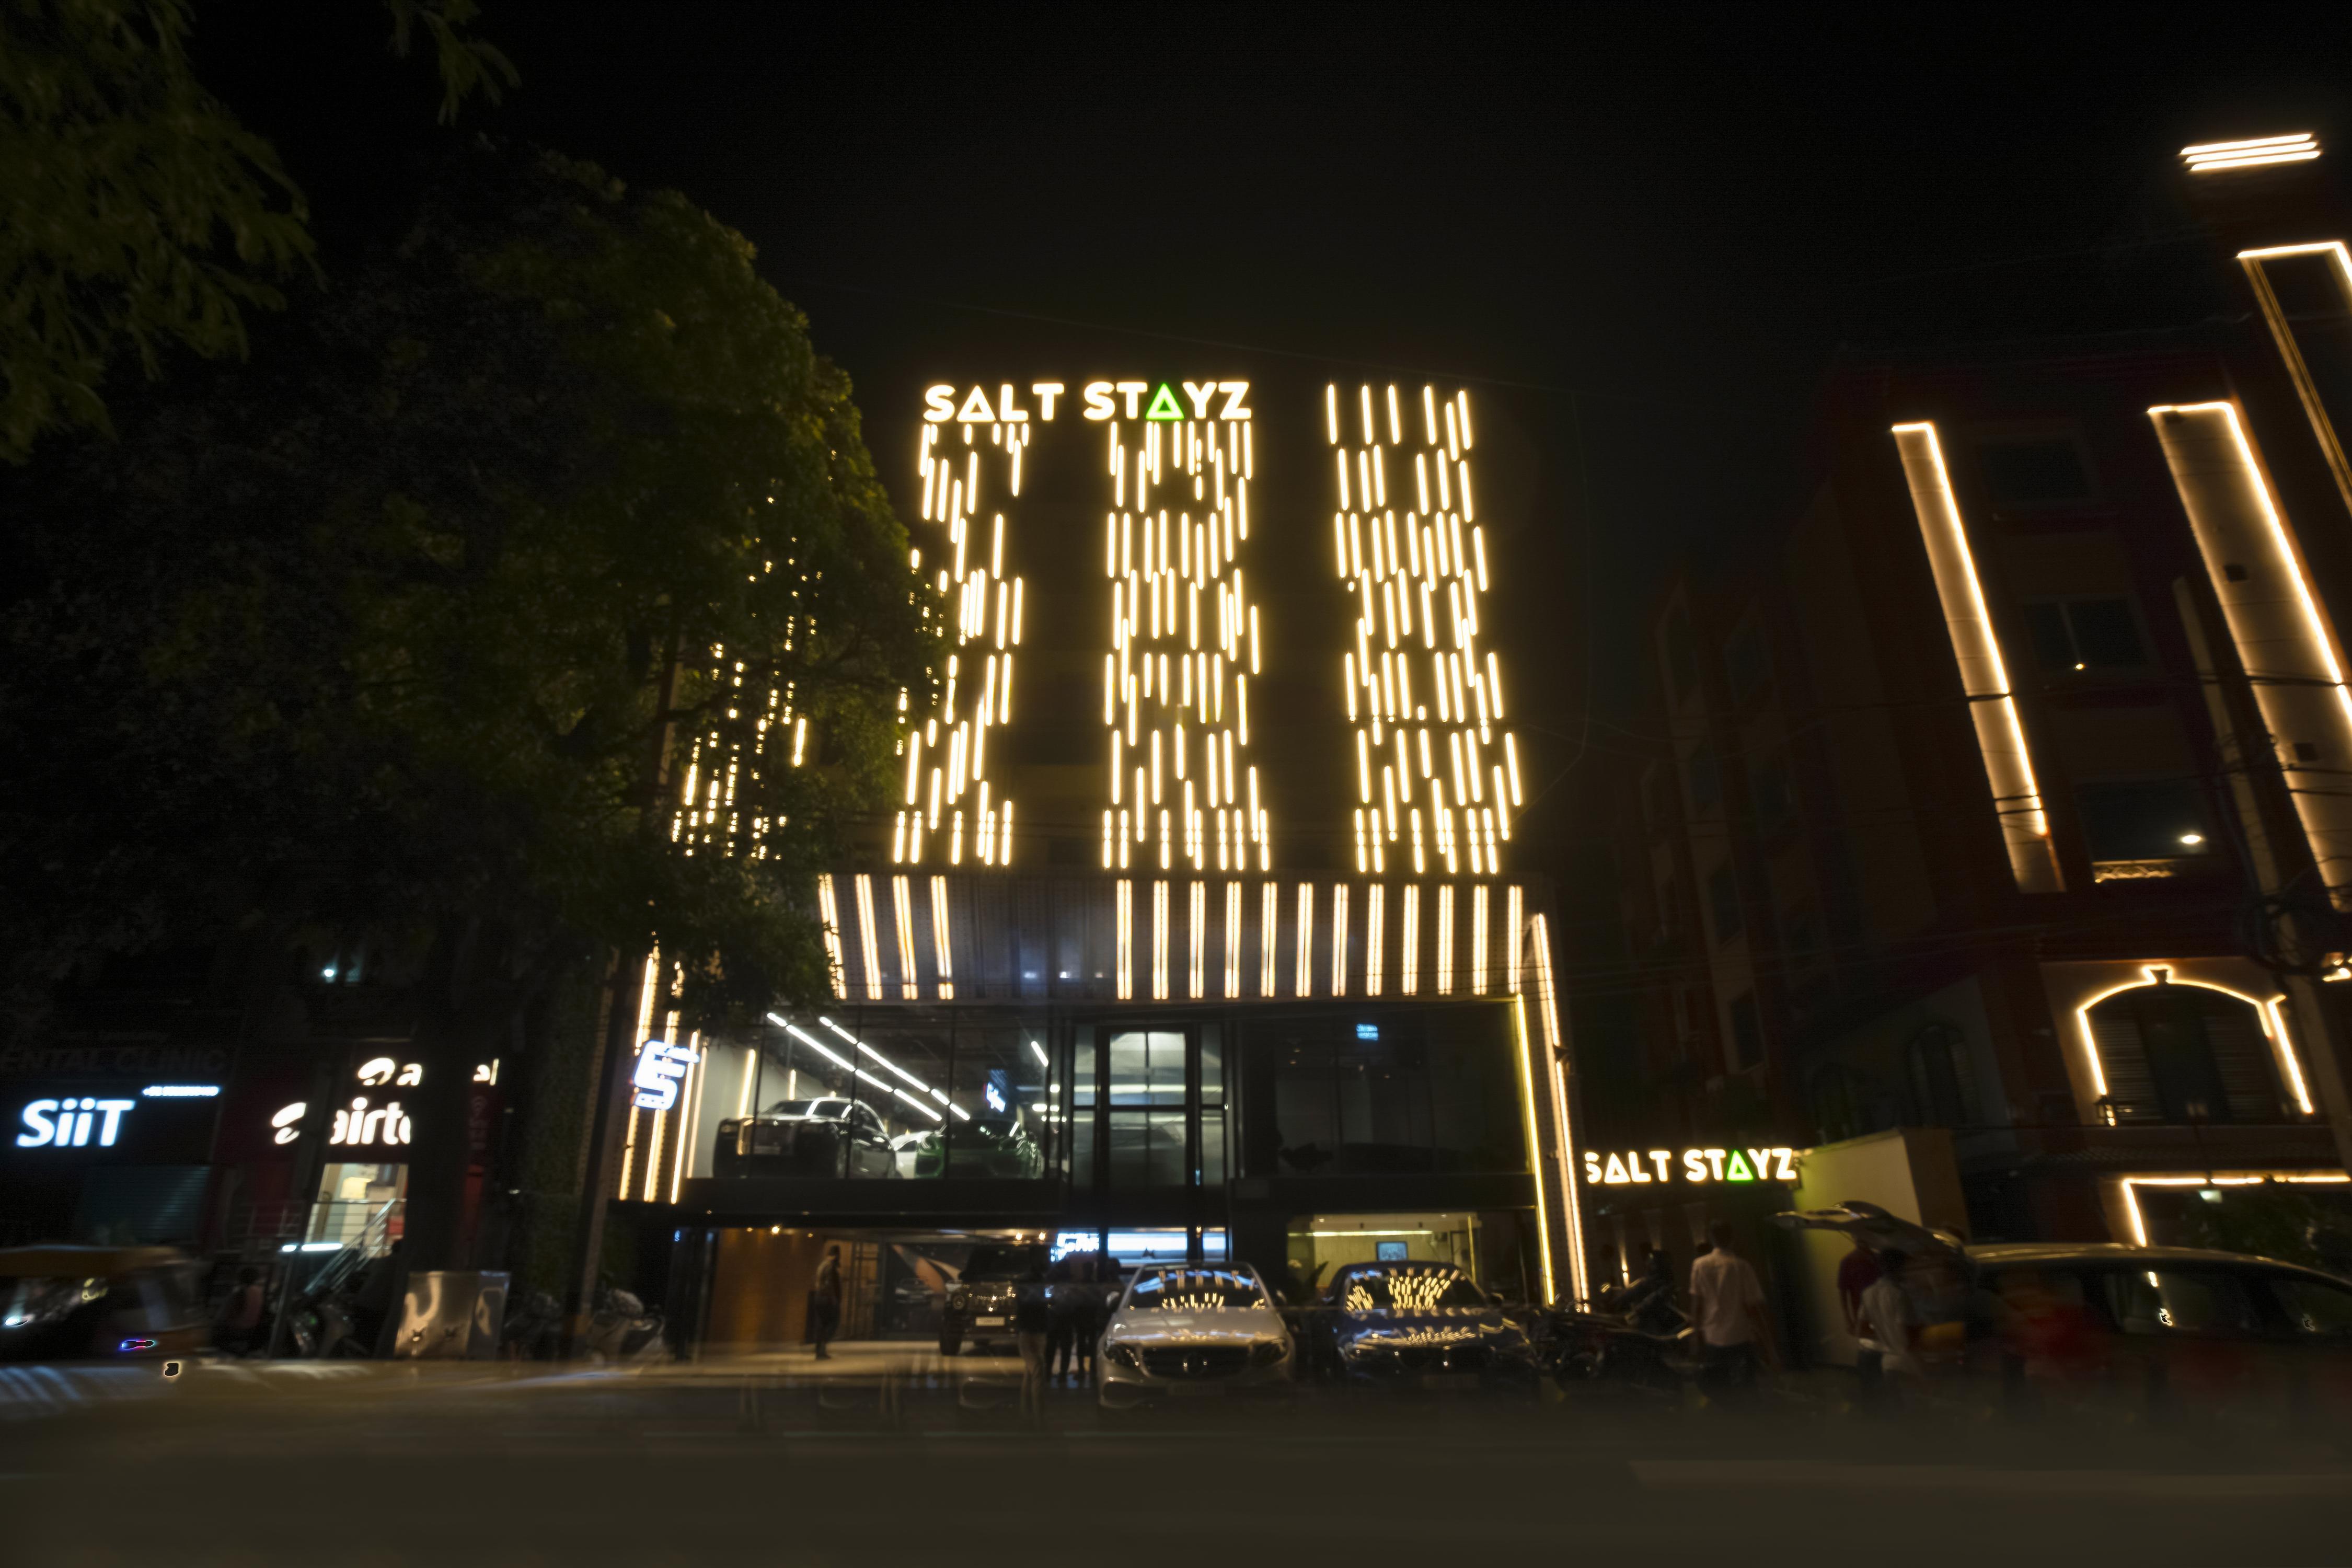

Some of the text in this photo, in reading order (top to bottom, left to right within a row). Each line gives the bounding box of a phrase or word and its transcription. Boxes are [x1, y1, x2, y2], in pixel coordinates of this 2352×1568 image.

[923, 381, 1252, 422] SALT STAYZ
[16, 1097, 136, 1147] SiiT
[330, 1097, 411, 1145] airt
[1585, 1148, 1797, 1183] SALT STAYZ
